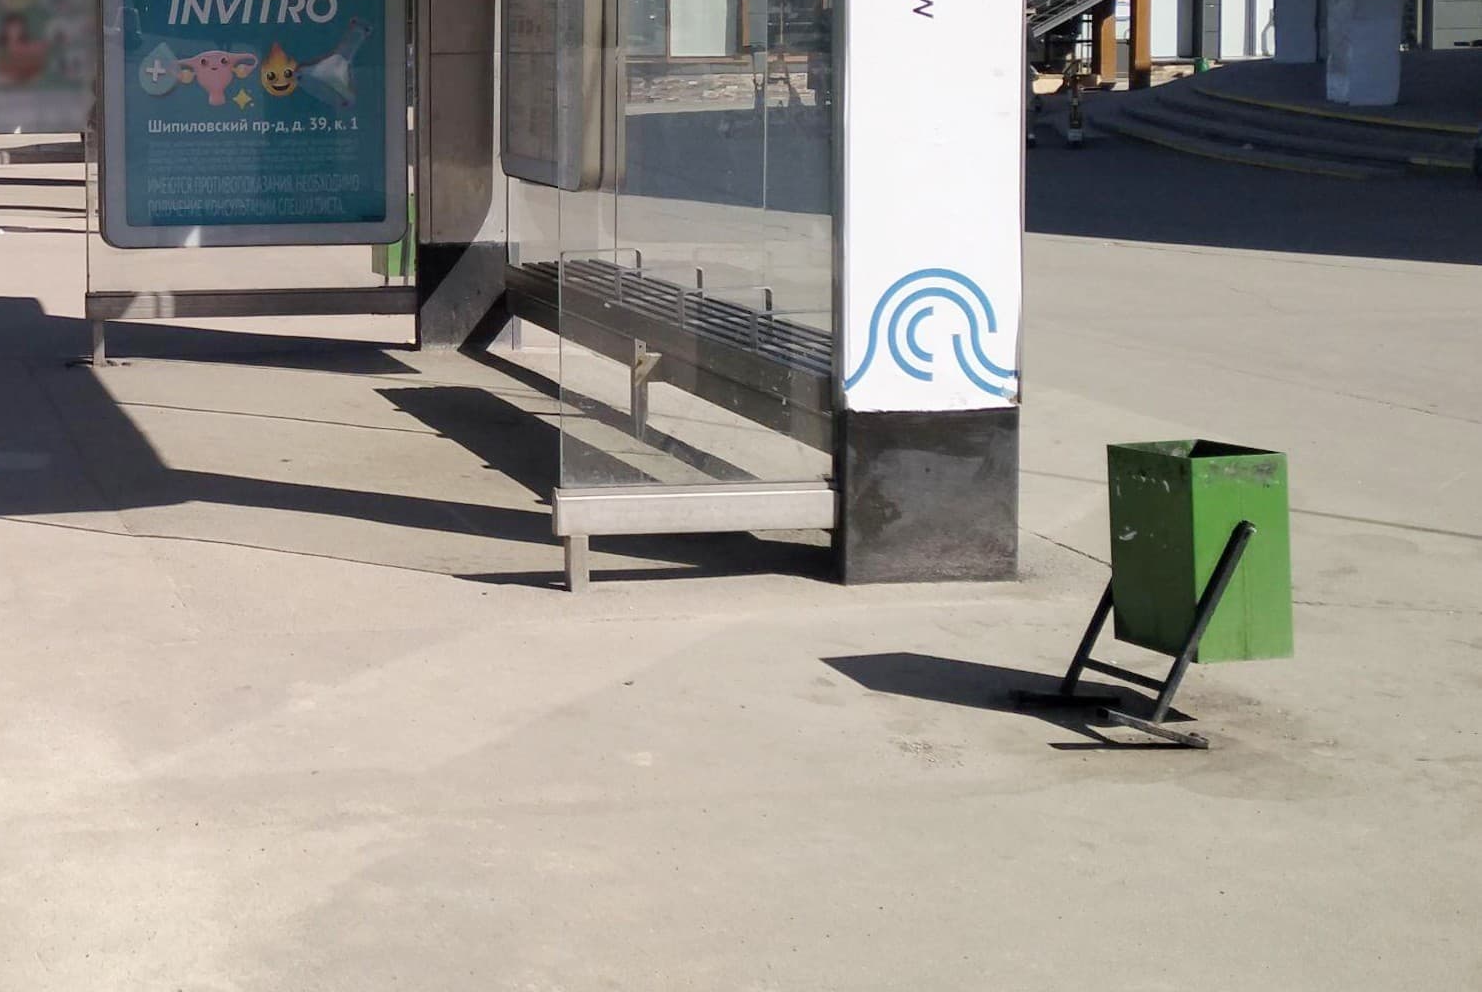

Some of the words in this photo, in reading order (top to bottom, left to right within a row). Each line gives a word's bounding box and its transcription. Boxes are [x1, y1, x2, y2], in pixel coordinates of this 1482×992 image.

[148, 119, 248, 133] Шипиловский
[252, 120, 289, 134] пр-д,
[309, 117, 332, 132] 39,
[334, 120, 347, 130] к.
[350, 117, 359, 130] 1
